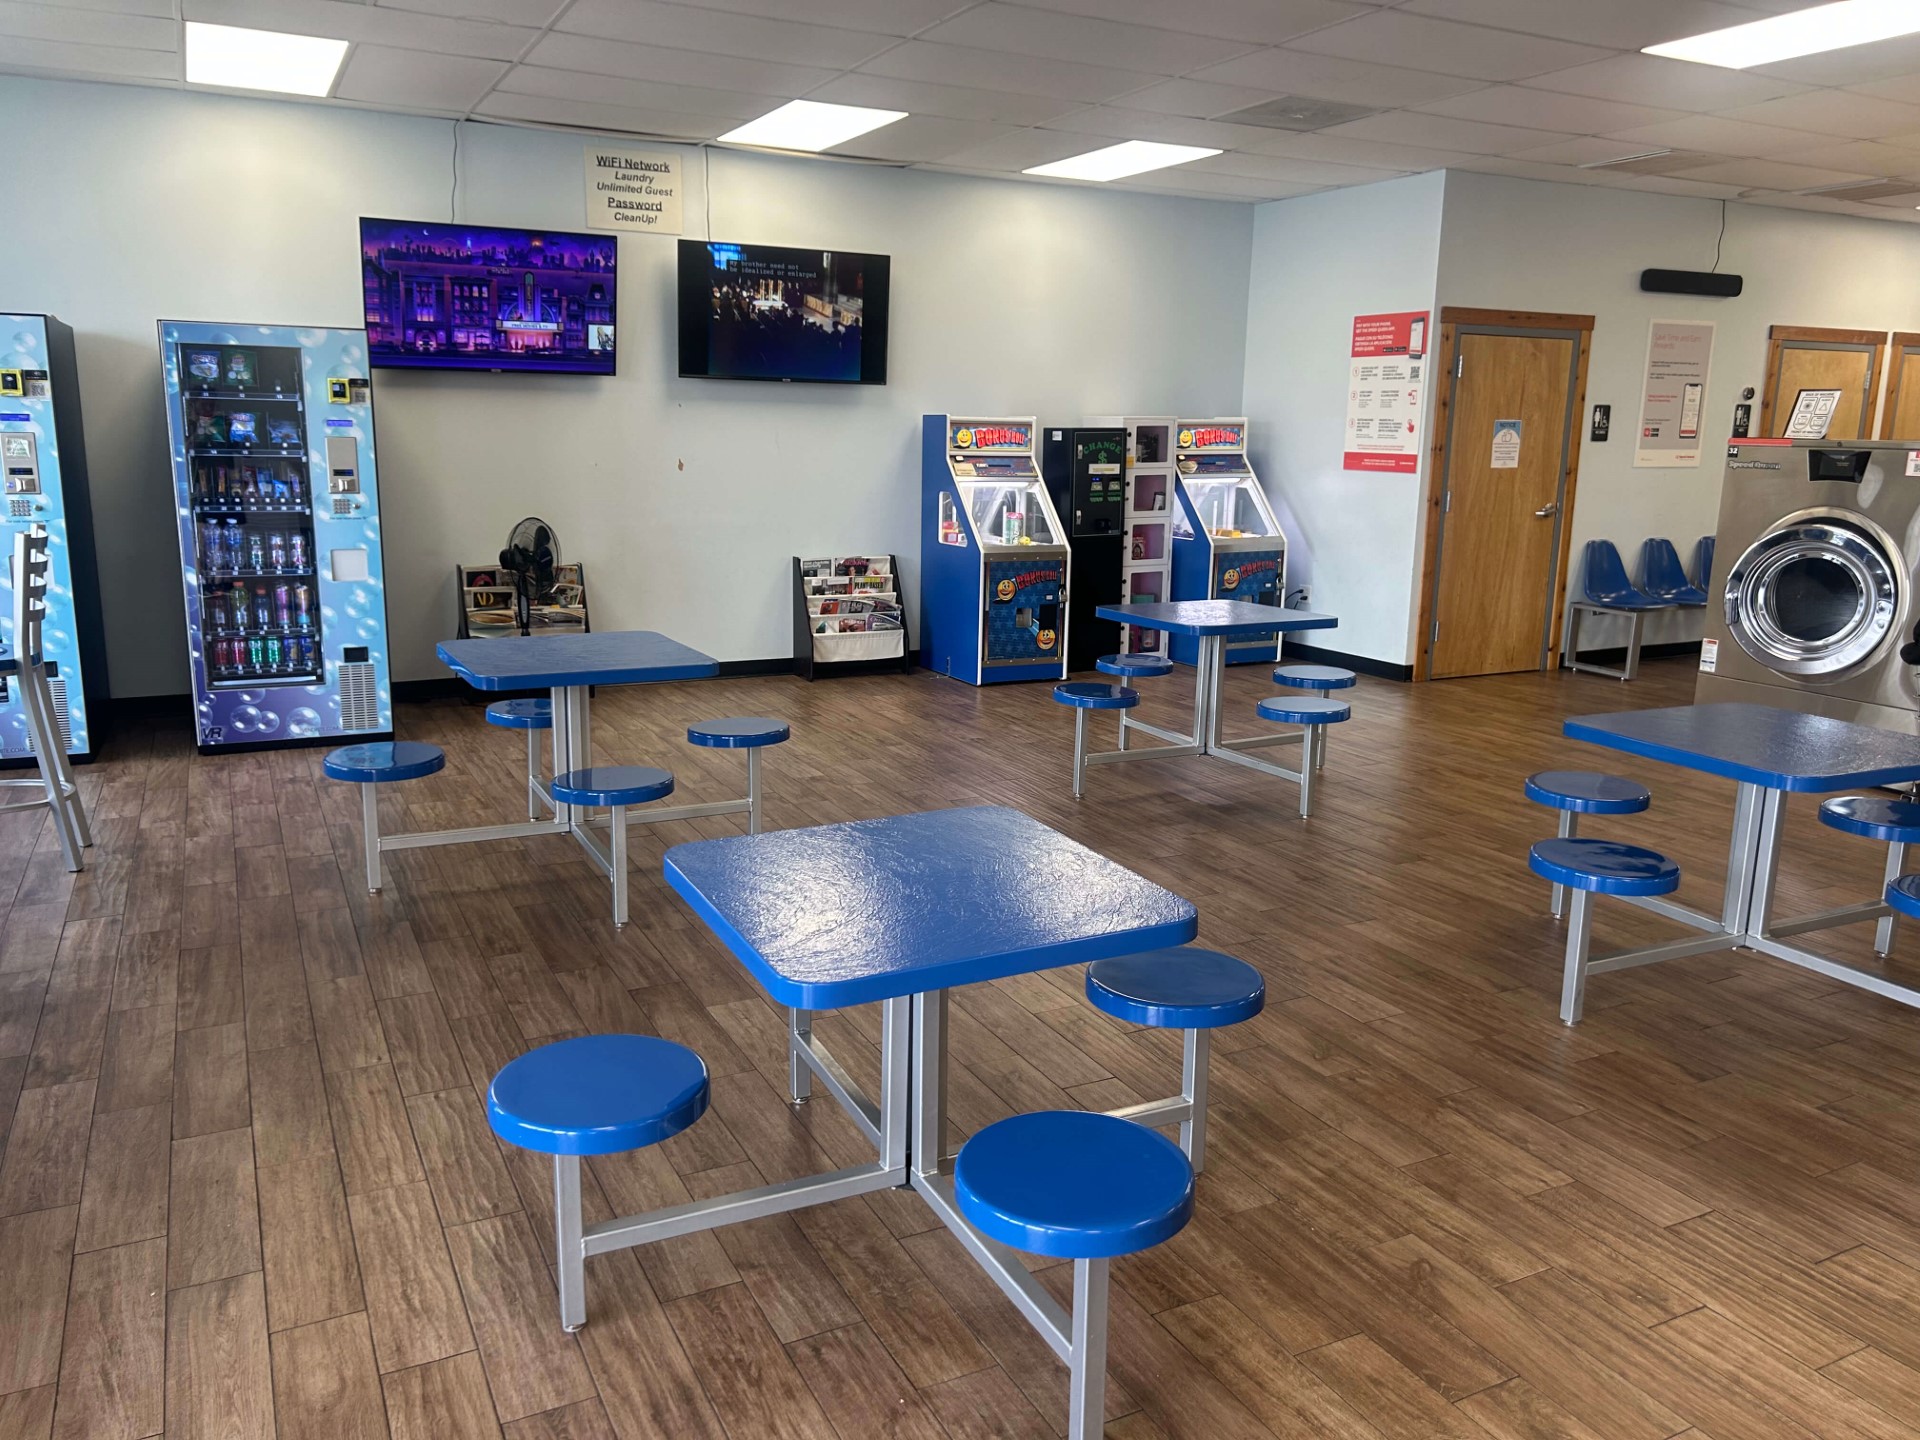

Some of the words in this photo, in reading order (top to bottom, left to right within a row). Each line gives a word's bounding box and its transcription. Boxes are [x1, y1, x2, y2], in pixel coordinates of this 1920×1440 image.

[596, 155, 622, 169] WiFi
[625, 158, 670, 173] Network
[615, 171, 654, 184] Laundry
[597, 182, 642, 194] Unlimited
[645, 186, 673, 197] Guest
[608, 197, 662, 212] Password
[614, 212, 657, 225] CleanUp!
[741, 261, 766, 269] brother
[741, 267, 773, 275] idealized
[975, 428, 1011, 449] BONUS
[1194, 429, 1226, 448] BONUS
[1083, 441, 1122, 454] CHANGE
[1728, 460, 1754, 470] Speed
[1016, 570, 1045, 590] BONUS
[202, 727, 222, 739] VR
